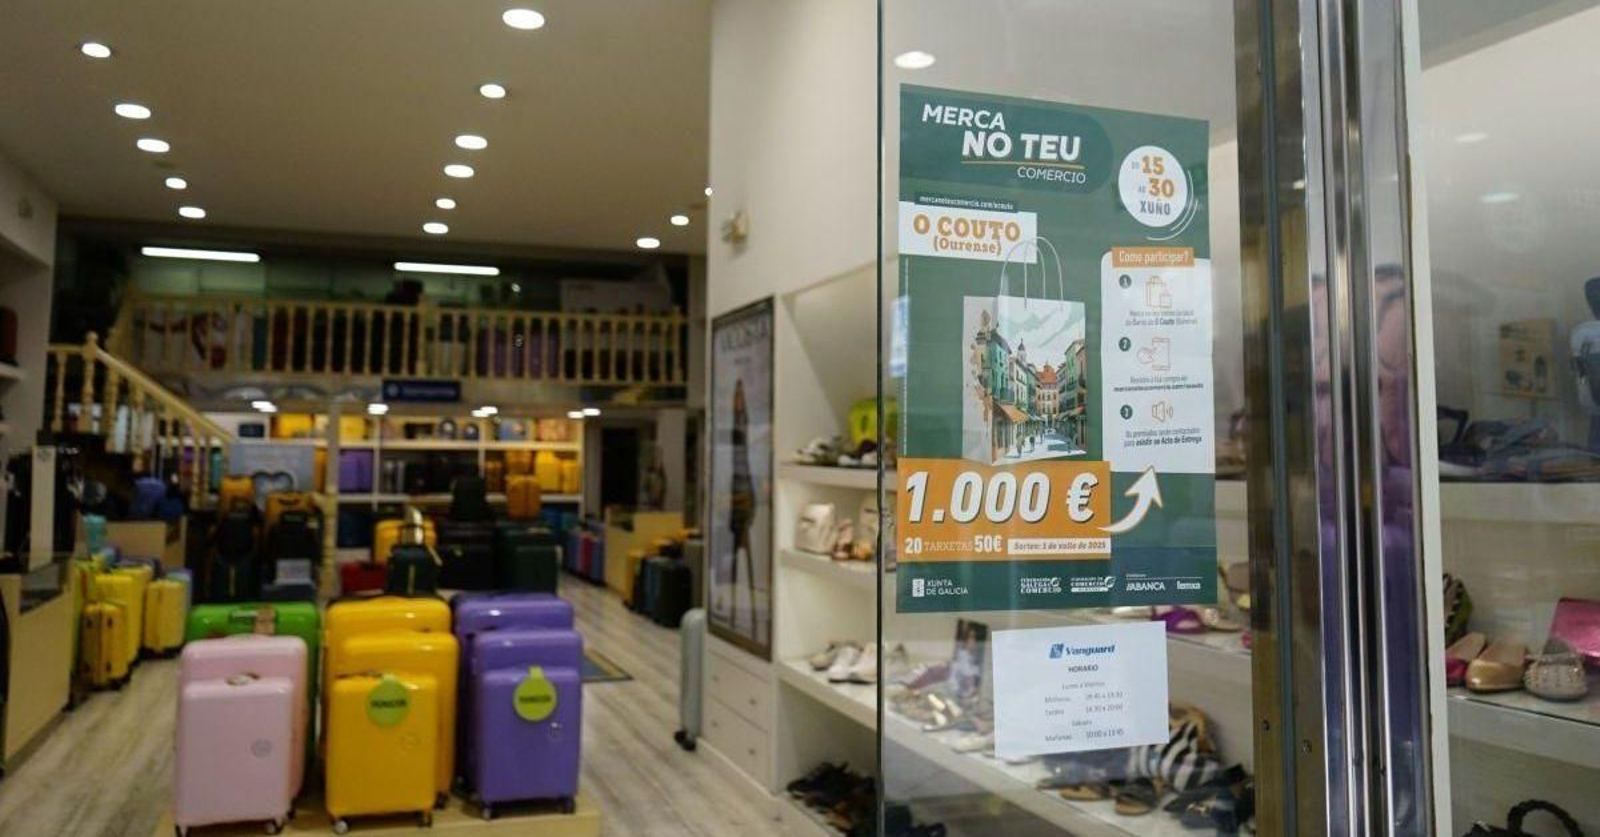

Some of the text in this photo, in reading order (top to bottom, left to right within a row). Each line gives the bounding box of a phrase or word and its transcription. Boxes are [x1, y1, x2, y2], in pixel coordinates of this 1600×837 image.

[922, 104, 1005, 130] MERCA
[962, 131, 1081, 161] NO TEU
[1142, 155, 1164, 175] 15
[1017, 166, 1086, 184] COMERCIO
[1149, 178, 1174, 198] 30
[1140, 198, 1171, 215] XUÑO
[913, 212, 1020, 242] O COUTO
[934, 235, 1002, 256] (Ourense)
[1119, 249, 1189, 265] Como participar?
[906, 471, 1099, 523] 1.000 €
[905, 534, 1002, 554] 20 TARXETAS 50€
[1048, 541, 1057, 550] de
[1078, 541, 1086, 550] de
[1088, 541, 1106, 550] 2025
[926, 579, 953, 587] XUNTA
[1126, 581, 1166, 591] ABANCA
[1066, 644, 1116, 656] Vanguard
[1068, 663, 1099, 673] HORARIO
